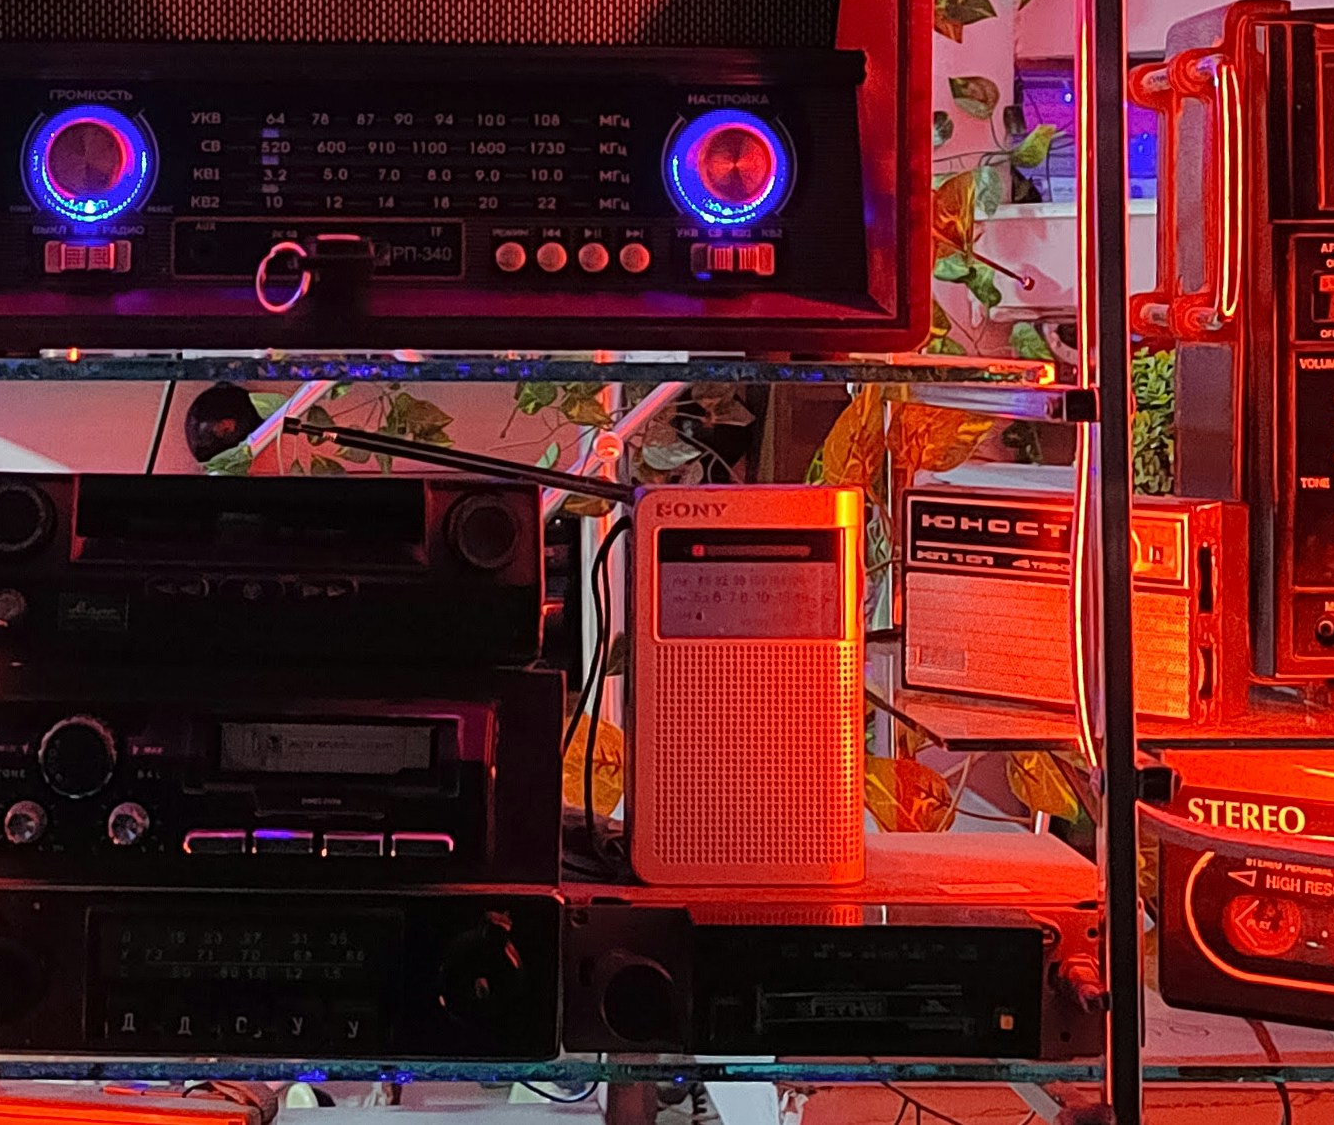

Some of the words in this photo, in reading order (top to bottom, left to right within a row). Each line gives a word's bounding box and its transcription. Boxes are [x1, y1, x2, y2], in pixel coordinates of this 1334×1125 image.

[49, 89, 133, 101] ГРОМКОСТЬ
[688, 93, 770, 105] НАСТРОЙКА
[191, 111, 222, 124] УКВ
[266, 113, 285, 124] 64
[312, 113, 330, 125] 78
[356, 113, 375, 125] 87
[394, 113, 413, 125] 90
[434, 114, 454, 125] 94
[477, 114, 506, 126] 100
[533, 114, 560, 126] 108
[599, 114, 631, 129] МГц
[200, 139, 222, 153] СВ
[261, 141, 291, 154] 520
[317, 141, 346, 154] 600
[368, 141, 396, 153] 910
[412, 141, 447, 154] 1100
[469, 141, 506, 155] 1600
[530, 142, 565, 155] 1730
[599, 142, 628, 156] КГц
[193, 168, 220, 181] КВ1
[263, 169, 288, 181] 3.2
[322, 168, 348, 181] 5.0
[378, 169, 400, 181] 7.0
[427, 169, 452, 181] 8.0
[475, 169, 500, 182] 9.0
[531, 169, 563, 181] 10.0
[599, 170, 631, 184] МГц
[191, 195, 220, 208] КВ2
[266, 196, 284, 208] 10
[326, 196, 343, 208] 12
[378, 196, 395, 208] 14
[478, 196, 498, 209] 20
[537, 197, 557, 210] 22
[599, 198, 631, 211] МГц
[393, 246, 452, 262] РП-340
[1300, 477, 1330, 489] TONE
[655, 502, 728, 518] SONY
[921, 514, 1068, 538] ЮНОСТ
[1187, 797, 1307, 834] STEREO
[1266, 874, 1301, 893] HIGH
